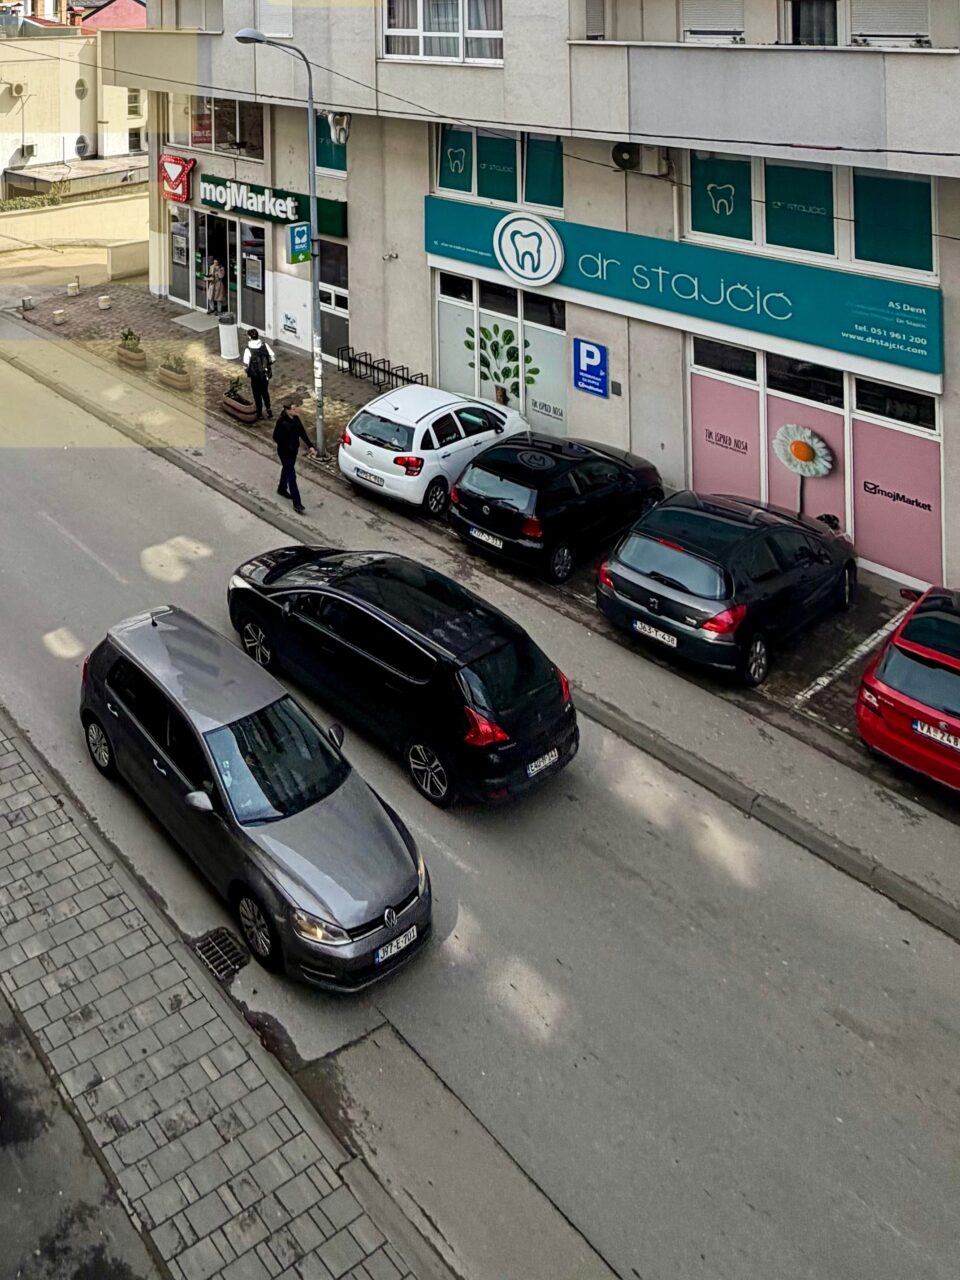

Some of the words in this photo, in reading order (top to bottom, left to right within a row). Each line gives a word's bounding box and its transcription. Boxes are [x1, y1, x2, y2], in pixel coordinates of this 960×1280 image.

[200, 180, 296, 220] mojMarket
[578, 252, 621, 280] dr
[888, 301, 901, 310] AS
[902, 303, 927, 315] Dent
[841, 331, 928, 356] www.drstajcic.com
[854, 324, 869, 332] tel.
[870, 327, 887, 337] 051
[889, 331, 906, 341] 961
[909, 335, 927, 345] 200
[580, 341, 601, 372] P
[877, 488, 932, 512] mojMarket
